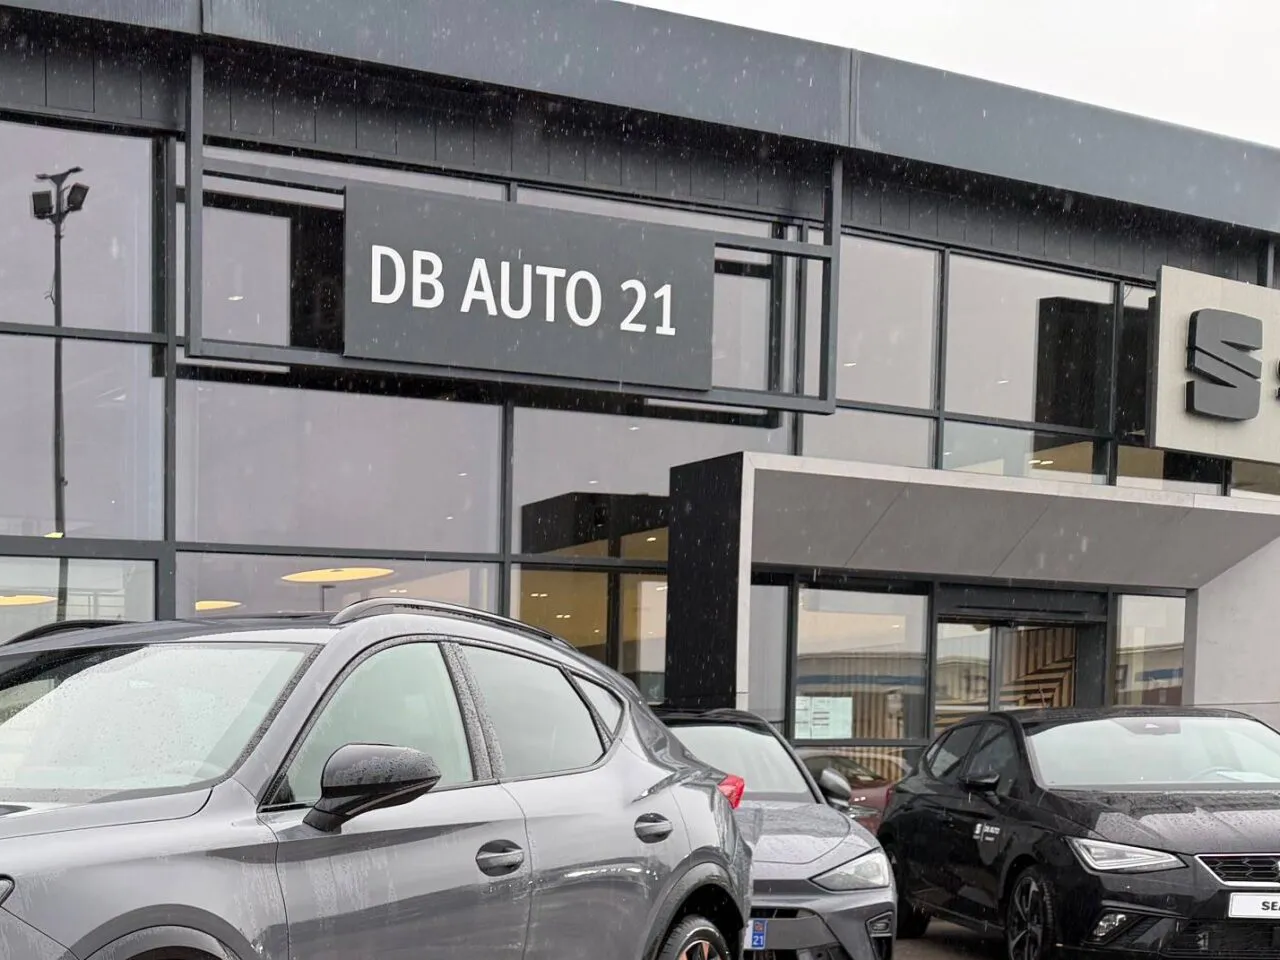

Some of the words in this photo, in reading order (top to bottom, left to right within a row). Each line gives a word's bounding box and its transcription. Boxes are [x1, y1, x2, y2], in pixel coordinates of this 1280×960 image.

[371, 244, 445, 309] DB
[460, 257, 602, 327] AUTO
[620, 279, 677, 336] 21
[1261, 901, 1280, 911] SE
[753, 935, 764, 946] 21
